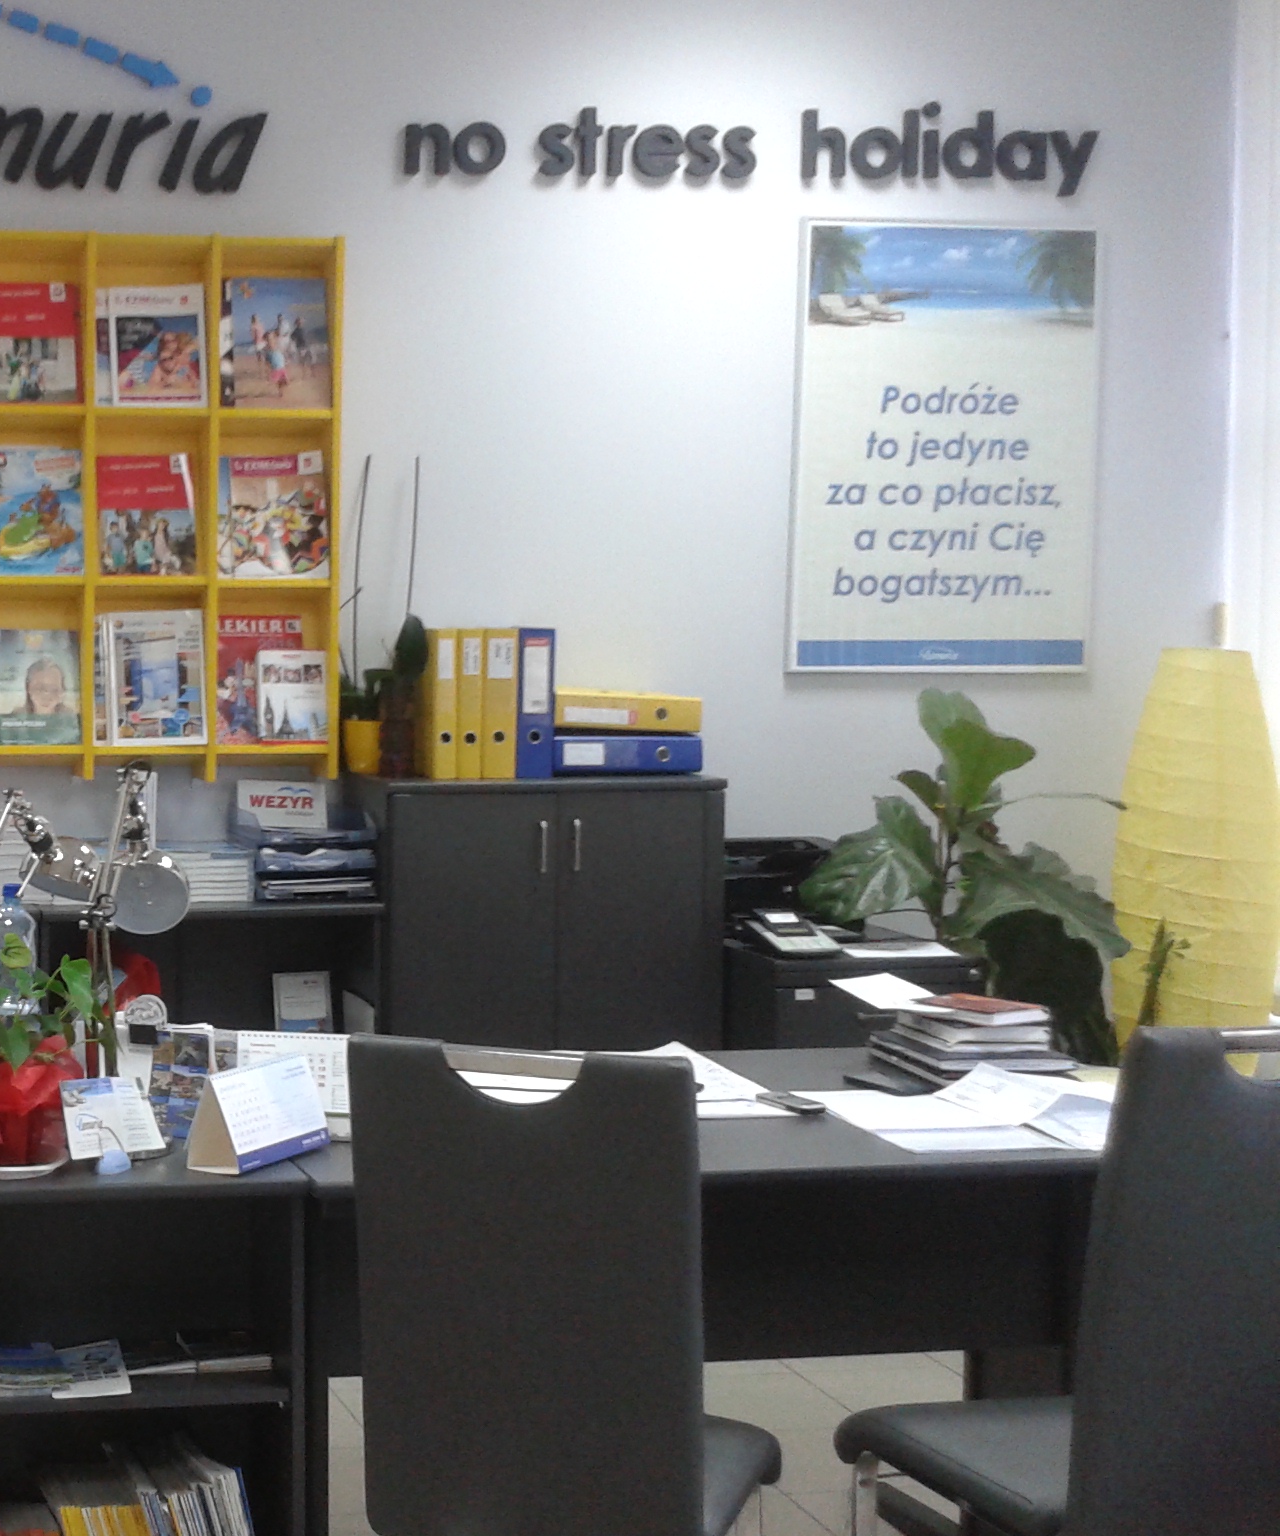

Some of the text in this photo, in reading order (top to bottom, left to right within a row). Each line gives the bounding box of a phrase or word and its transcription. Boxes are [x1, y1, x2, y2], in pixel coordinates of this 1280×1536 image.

[402, 101, 1101, 197] no stress holiday
[879, 383, 1020, 416] Podróże
[866, 432, 1030, 467] to jedyne
[826, 477, 1062, 512] za co płacisz,
[853, 522, 1046, 558] a czyni Cię
[832, 567, 1053, 604] bogatszym...
[249, 794, 314, 809] WEZYR
